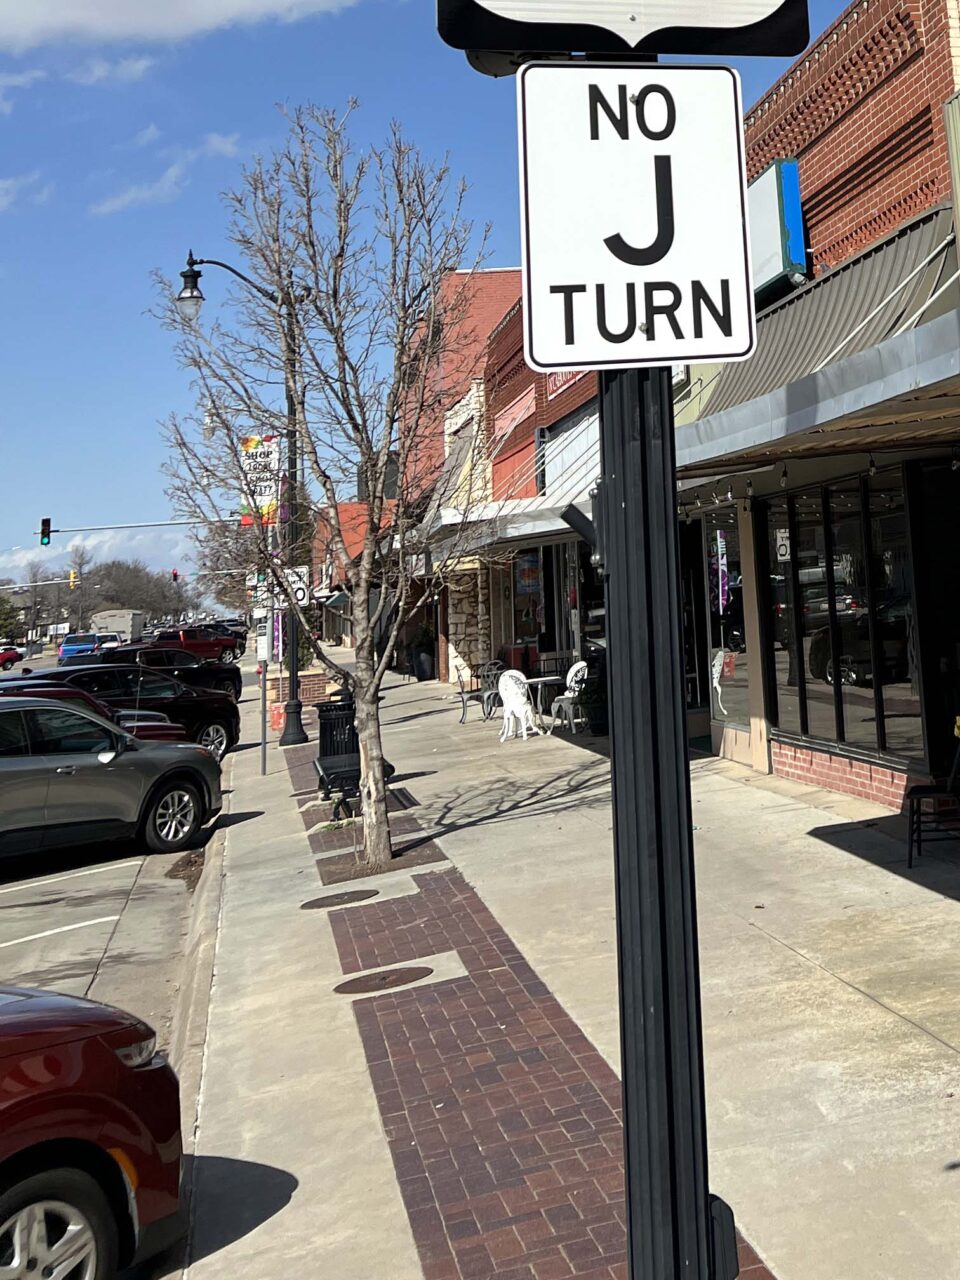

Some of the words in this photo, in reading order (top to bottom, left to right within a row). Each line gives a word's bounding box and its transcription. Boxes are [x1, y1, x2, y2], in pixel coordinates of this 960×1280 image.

[588, 84, 676, 141] NO
[603, 155, 675, 266] J
[550, 279, 733, 345] TURN
[244, 450, 273, 460] SHOP
